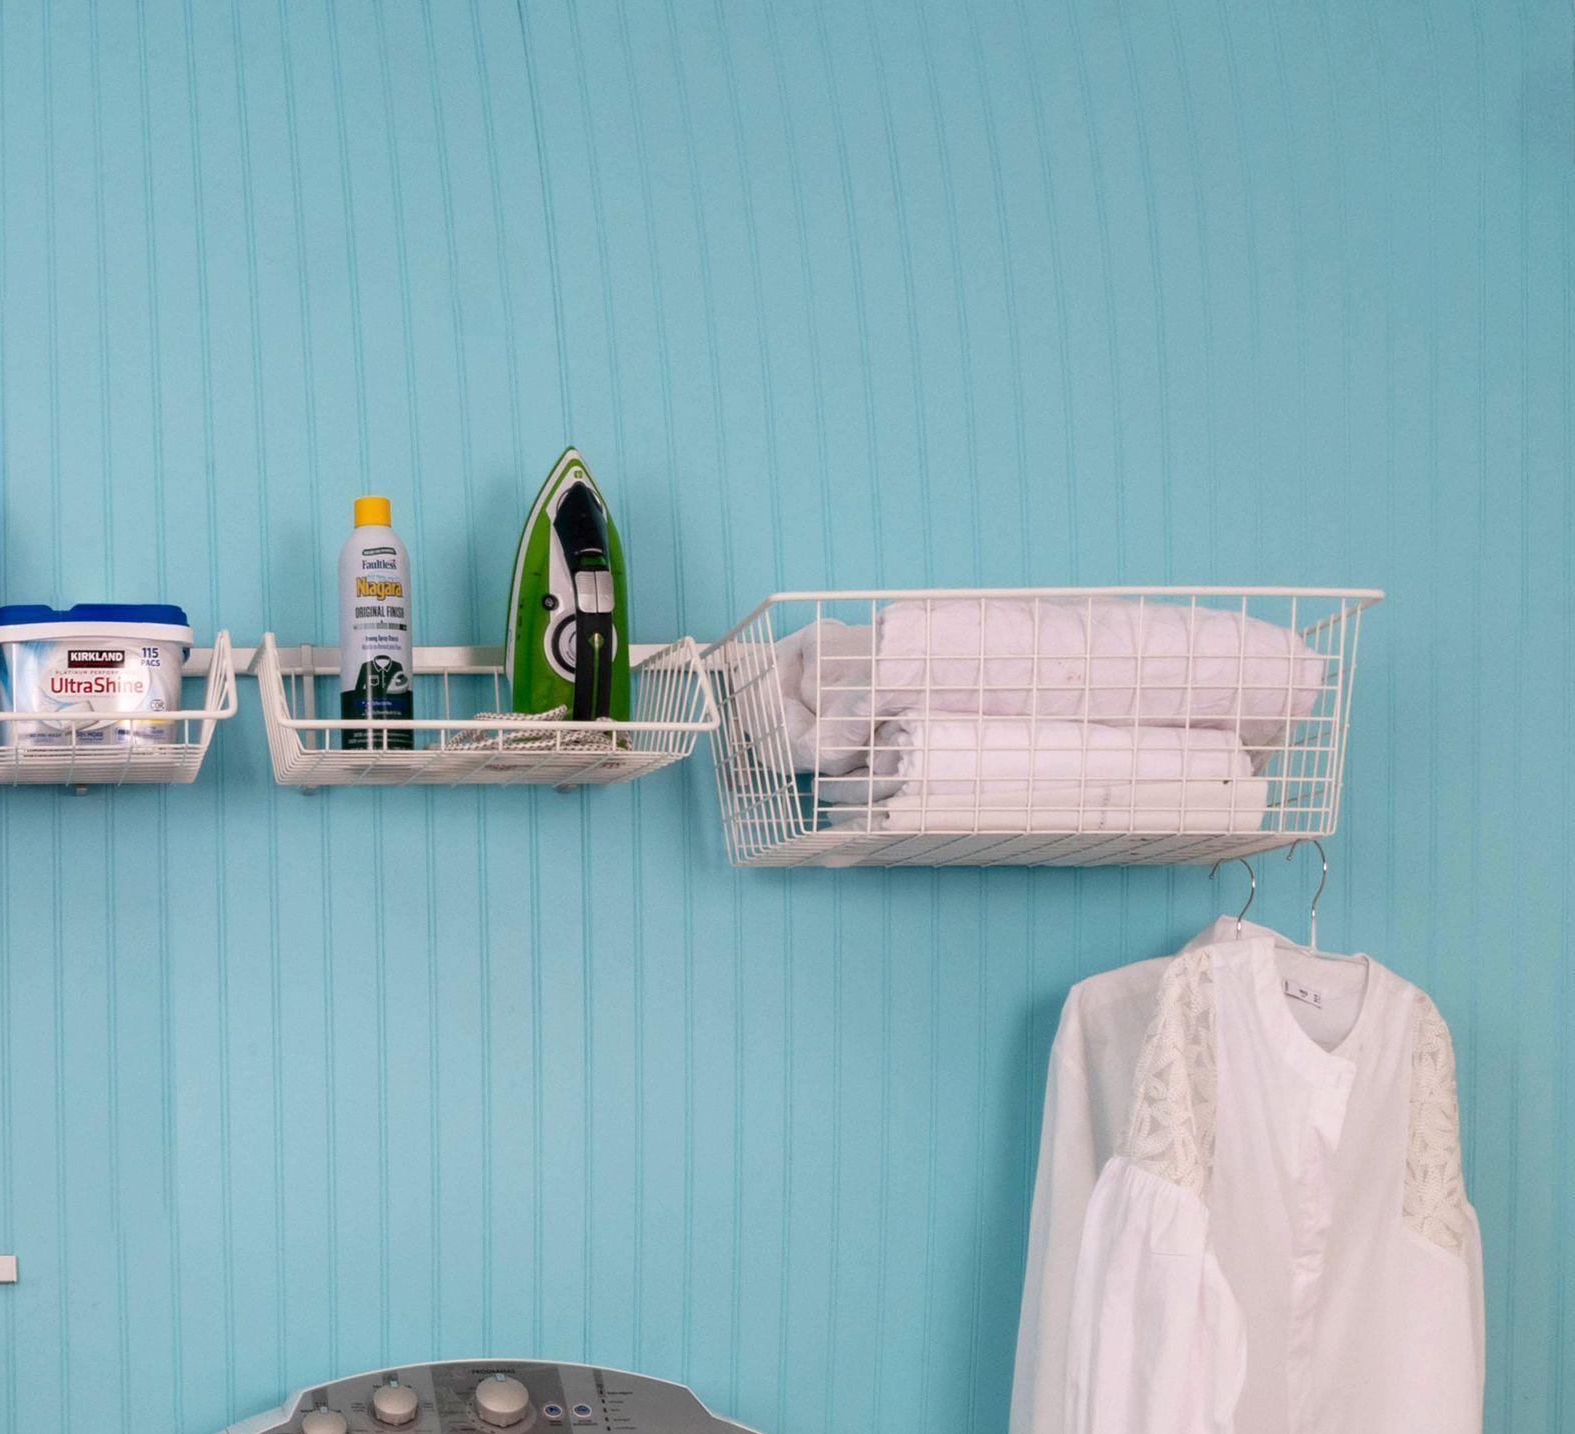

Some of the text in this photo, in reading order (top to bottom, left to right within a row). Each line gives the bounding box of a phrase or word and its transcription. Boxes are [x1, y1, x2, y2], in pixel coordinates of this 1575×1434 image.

[361, 559, 397, 570] Faultless
[356, 576, 403, 600] Niagara
[355, 605, 385, 619] ORIGINAL
[70, 652, 123, 662] KIRKLAND
[141, 647, 159, 659] 115
[141, 659, 161, 667] PACS
[50, 677, 144, 694] UltraShine
